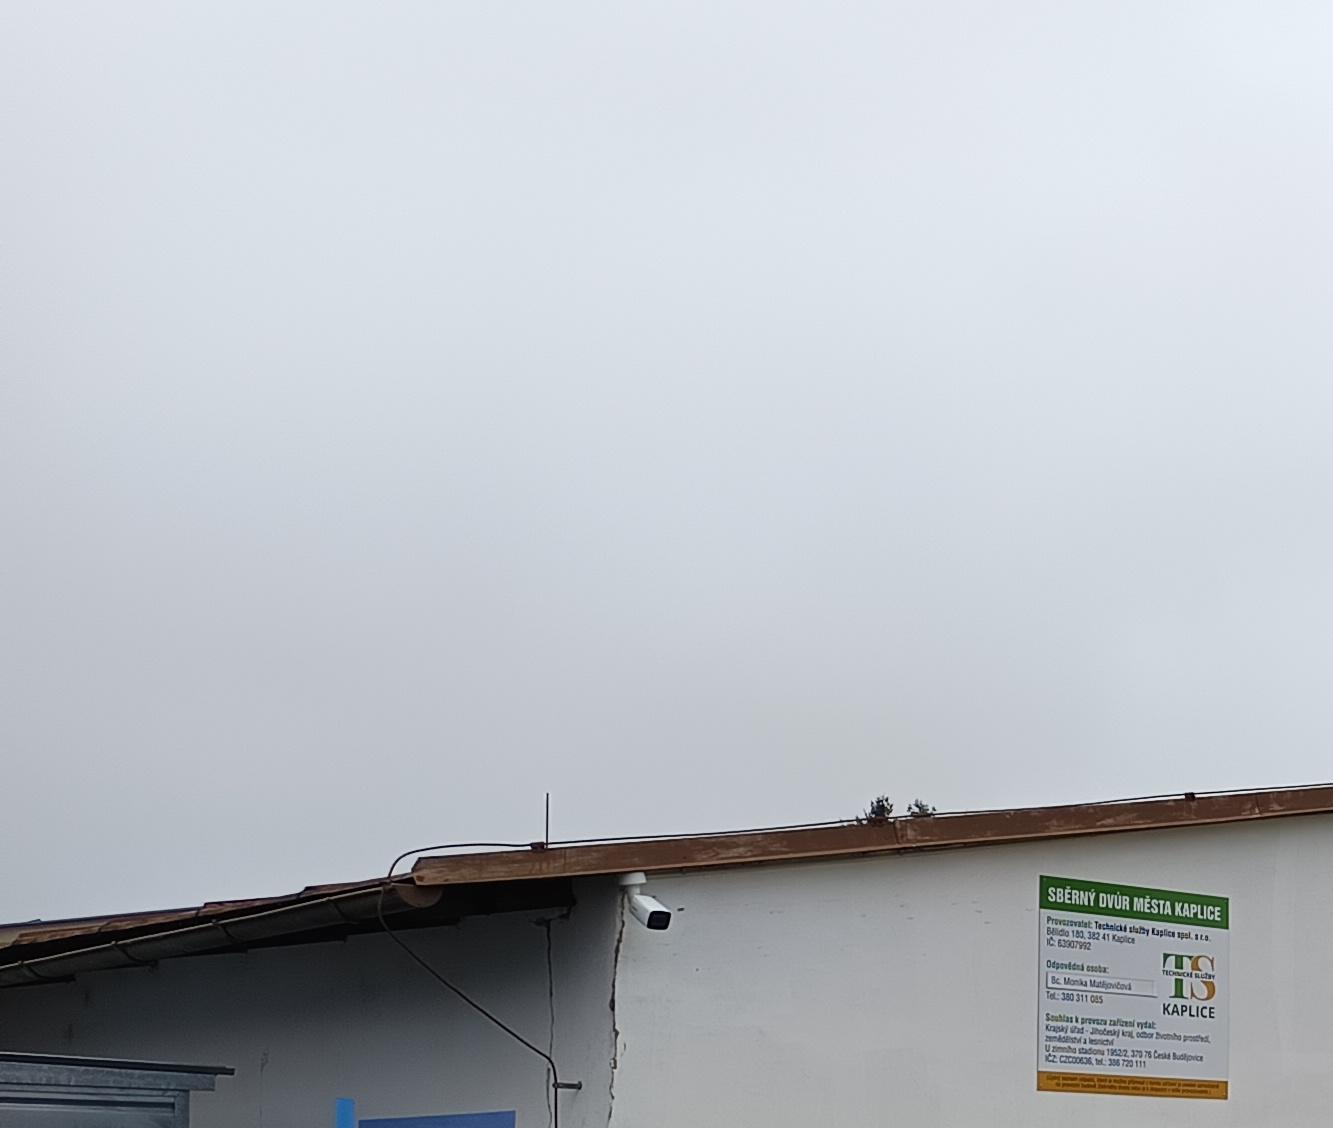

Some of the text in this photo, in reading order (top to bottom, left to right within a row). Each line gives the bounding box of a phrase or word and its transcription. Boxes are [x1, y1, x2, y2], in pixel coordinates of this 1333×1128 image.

[1048, 886, 1222, 921] SBĚRNÝ DVŮR MĚSTA KAPLICE
[1095, 921, 1128, 932] Technické
[1129, 925, 1150, 936] služby
[1151, 928, 1176, 939] Kaplice
[1088, 932, 1100, 941] 382
[1101, 933, 1110, 942] 41
[1112, 933, 1136, 944] Kaplice
[1046, 960, 1110, 974] Odpovědná osoba:
[1064, 977, 1088, 988] Monika
[1195, 971, 1216, 980] SLUŽBY
[1076, 993, 1088, 1003] 311
[1162, 1003, 1216, 1019] KAPLICE
[1045, 1012, 1073, 1023] Souhlas
[1081, 1017, 1107, 1026] provozu
[1109, 1017, 1135, 1028] zařízení
[1045, 1024, 1068, 1034] Krajský
[1090, 1027, 1120, 1038] Jihočeský
[1136, 1031, 1154, 1040] odbor
[1045, 1044, 1051, 1053] U
[1153, 1050, 1171, 1060] České
[1172, 1052, 1204, 1063] Budějovice
[1135, 1061, 1146, 1069] 111
